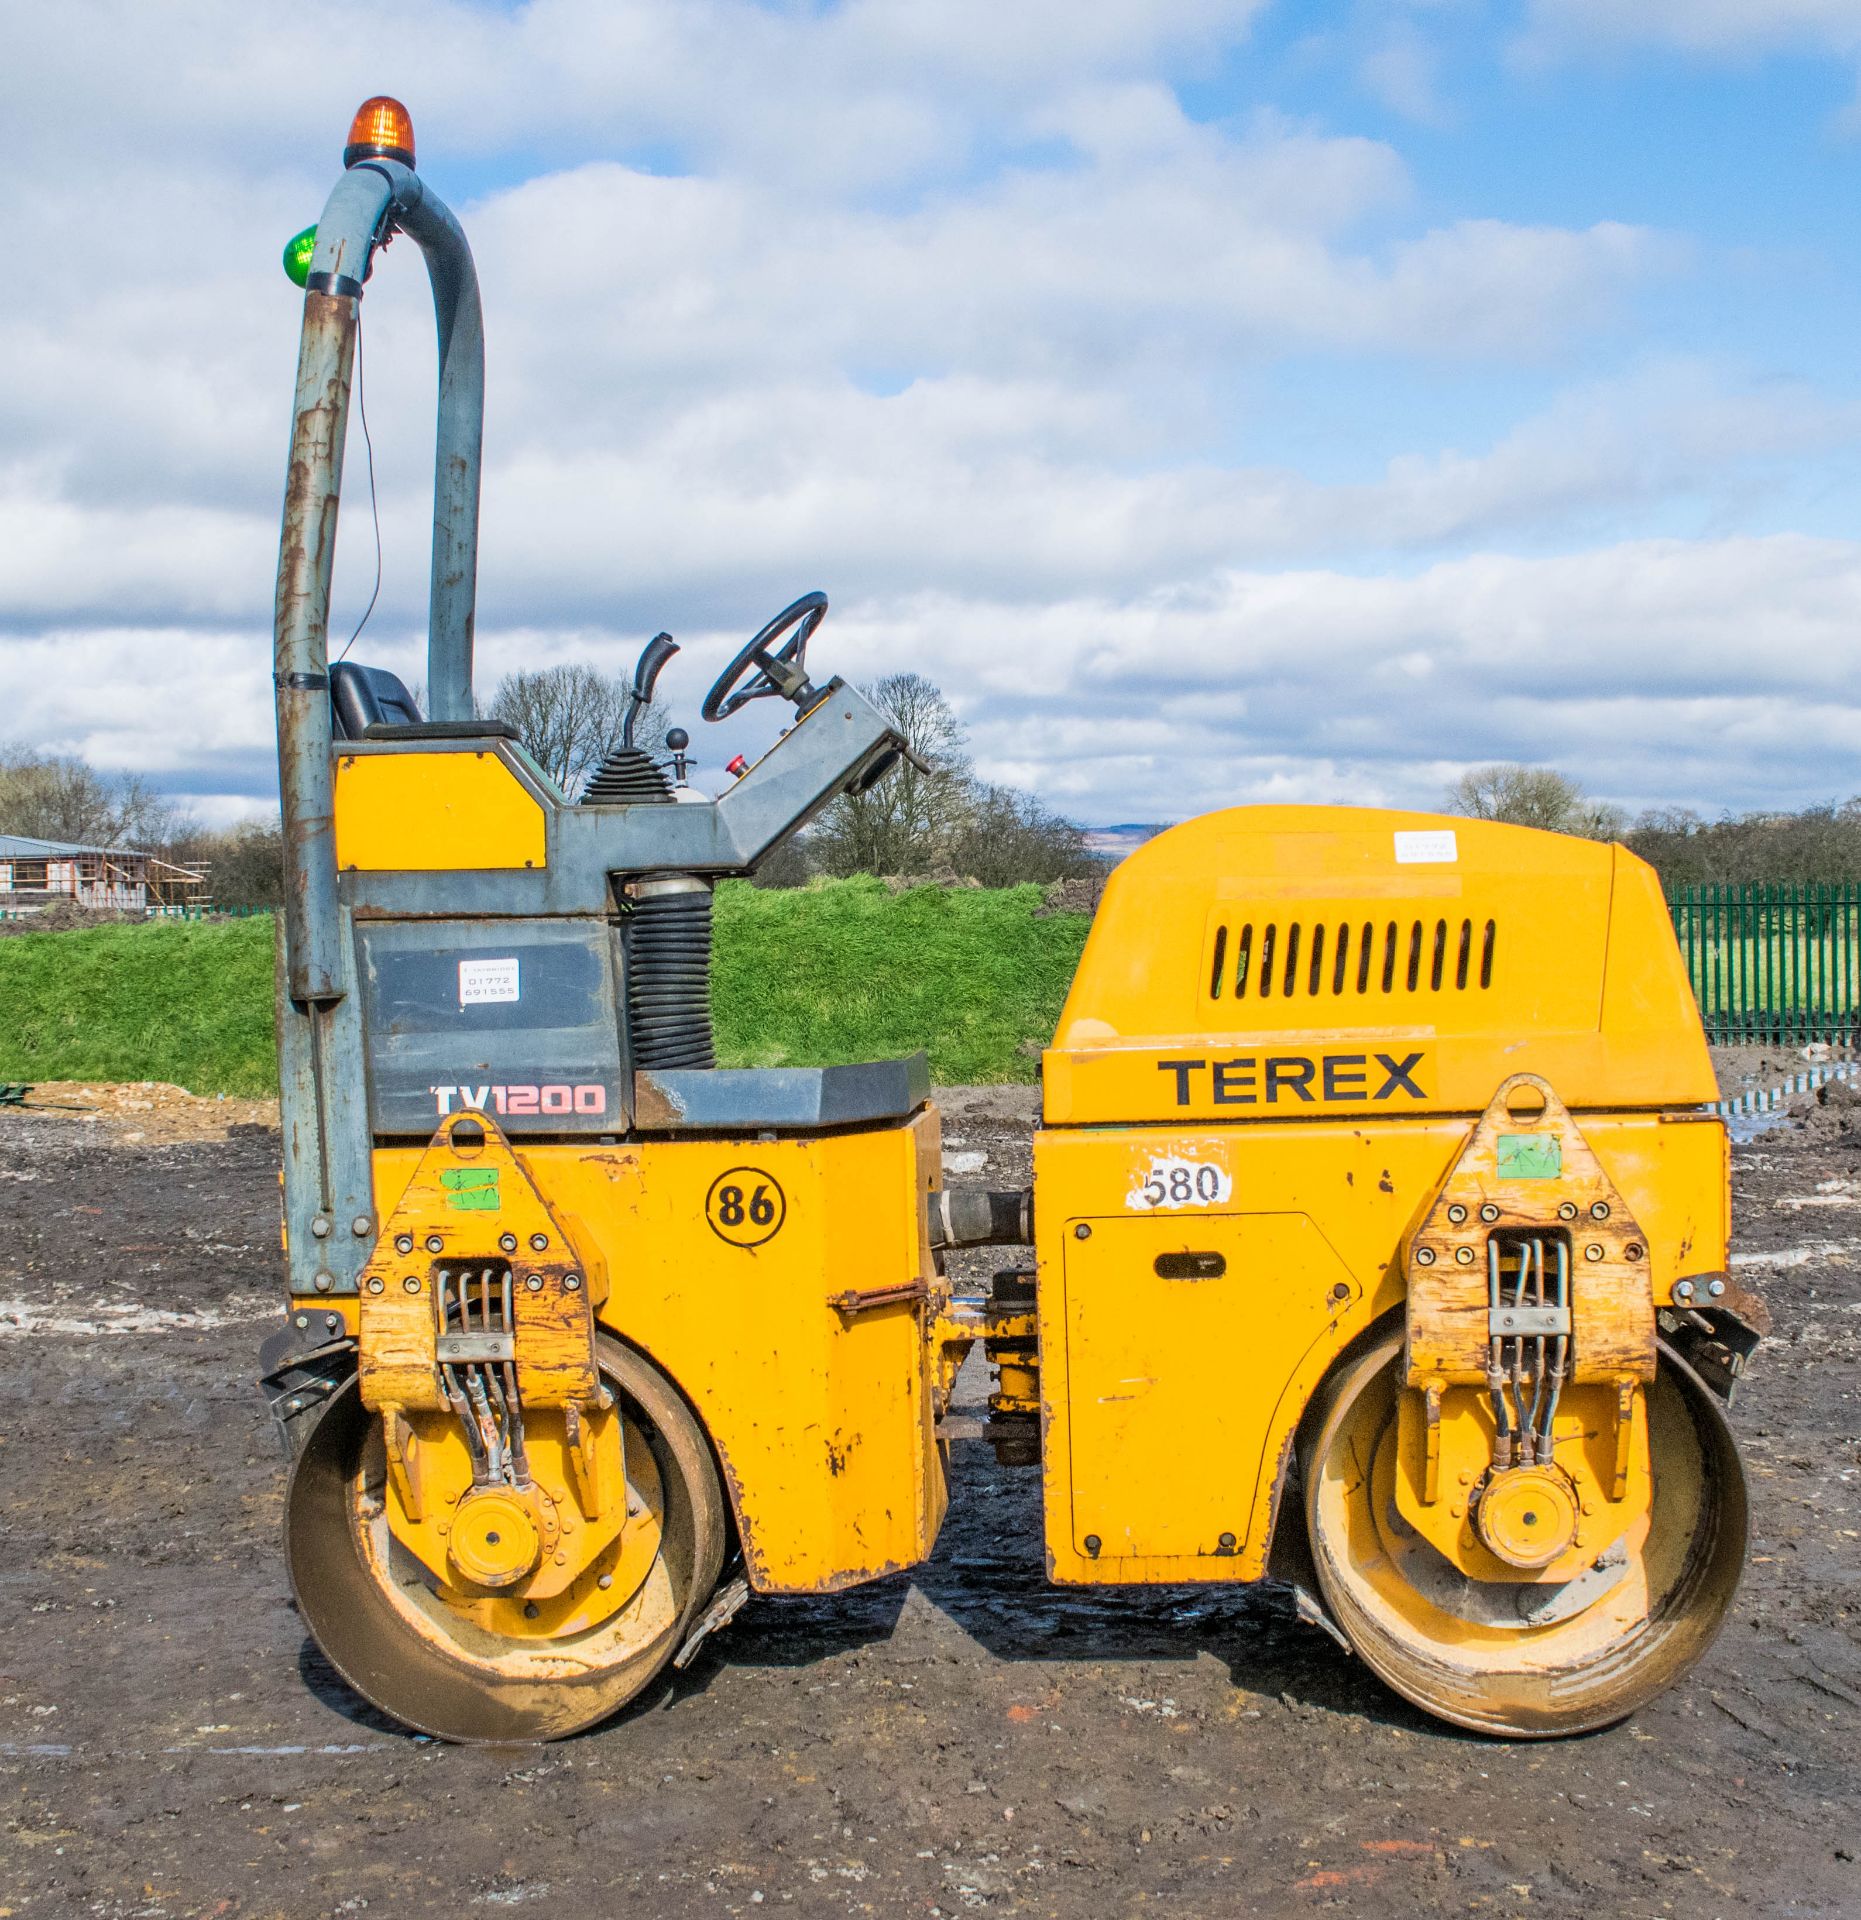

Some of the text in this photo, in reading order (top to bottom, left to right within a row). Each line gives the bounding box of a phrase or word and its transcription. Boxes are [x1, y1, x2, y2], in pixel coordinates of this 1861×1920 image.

[468, 977, 511, 986] 01772
[1158, 1053, 1427, 1105] TEREX
[430, 1085, 606, 1114] TV1200
[719, 1185, 775, 1226] 86
[1144, 1166, 1219, 1206] 580
